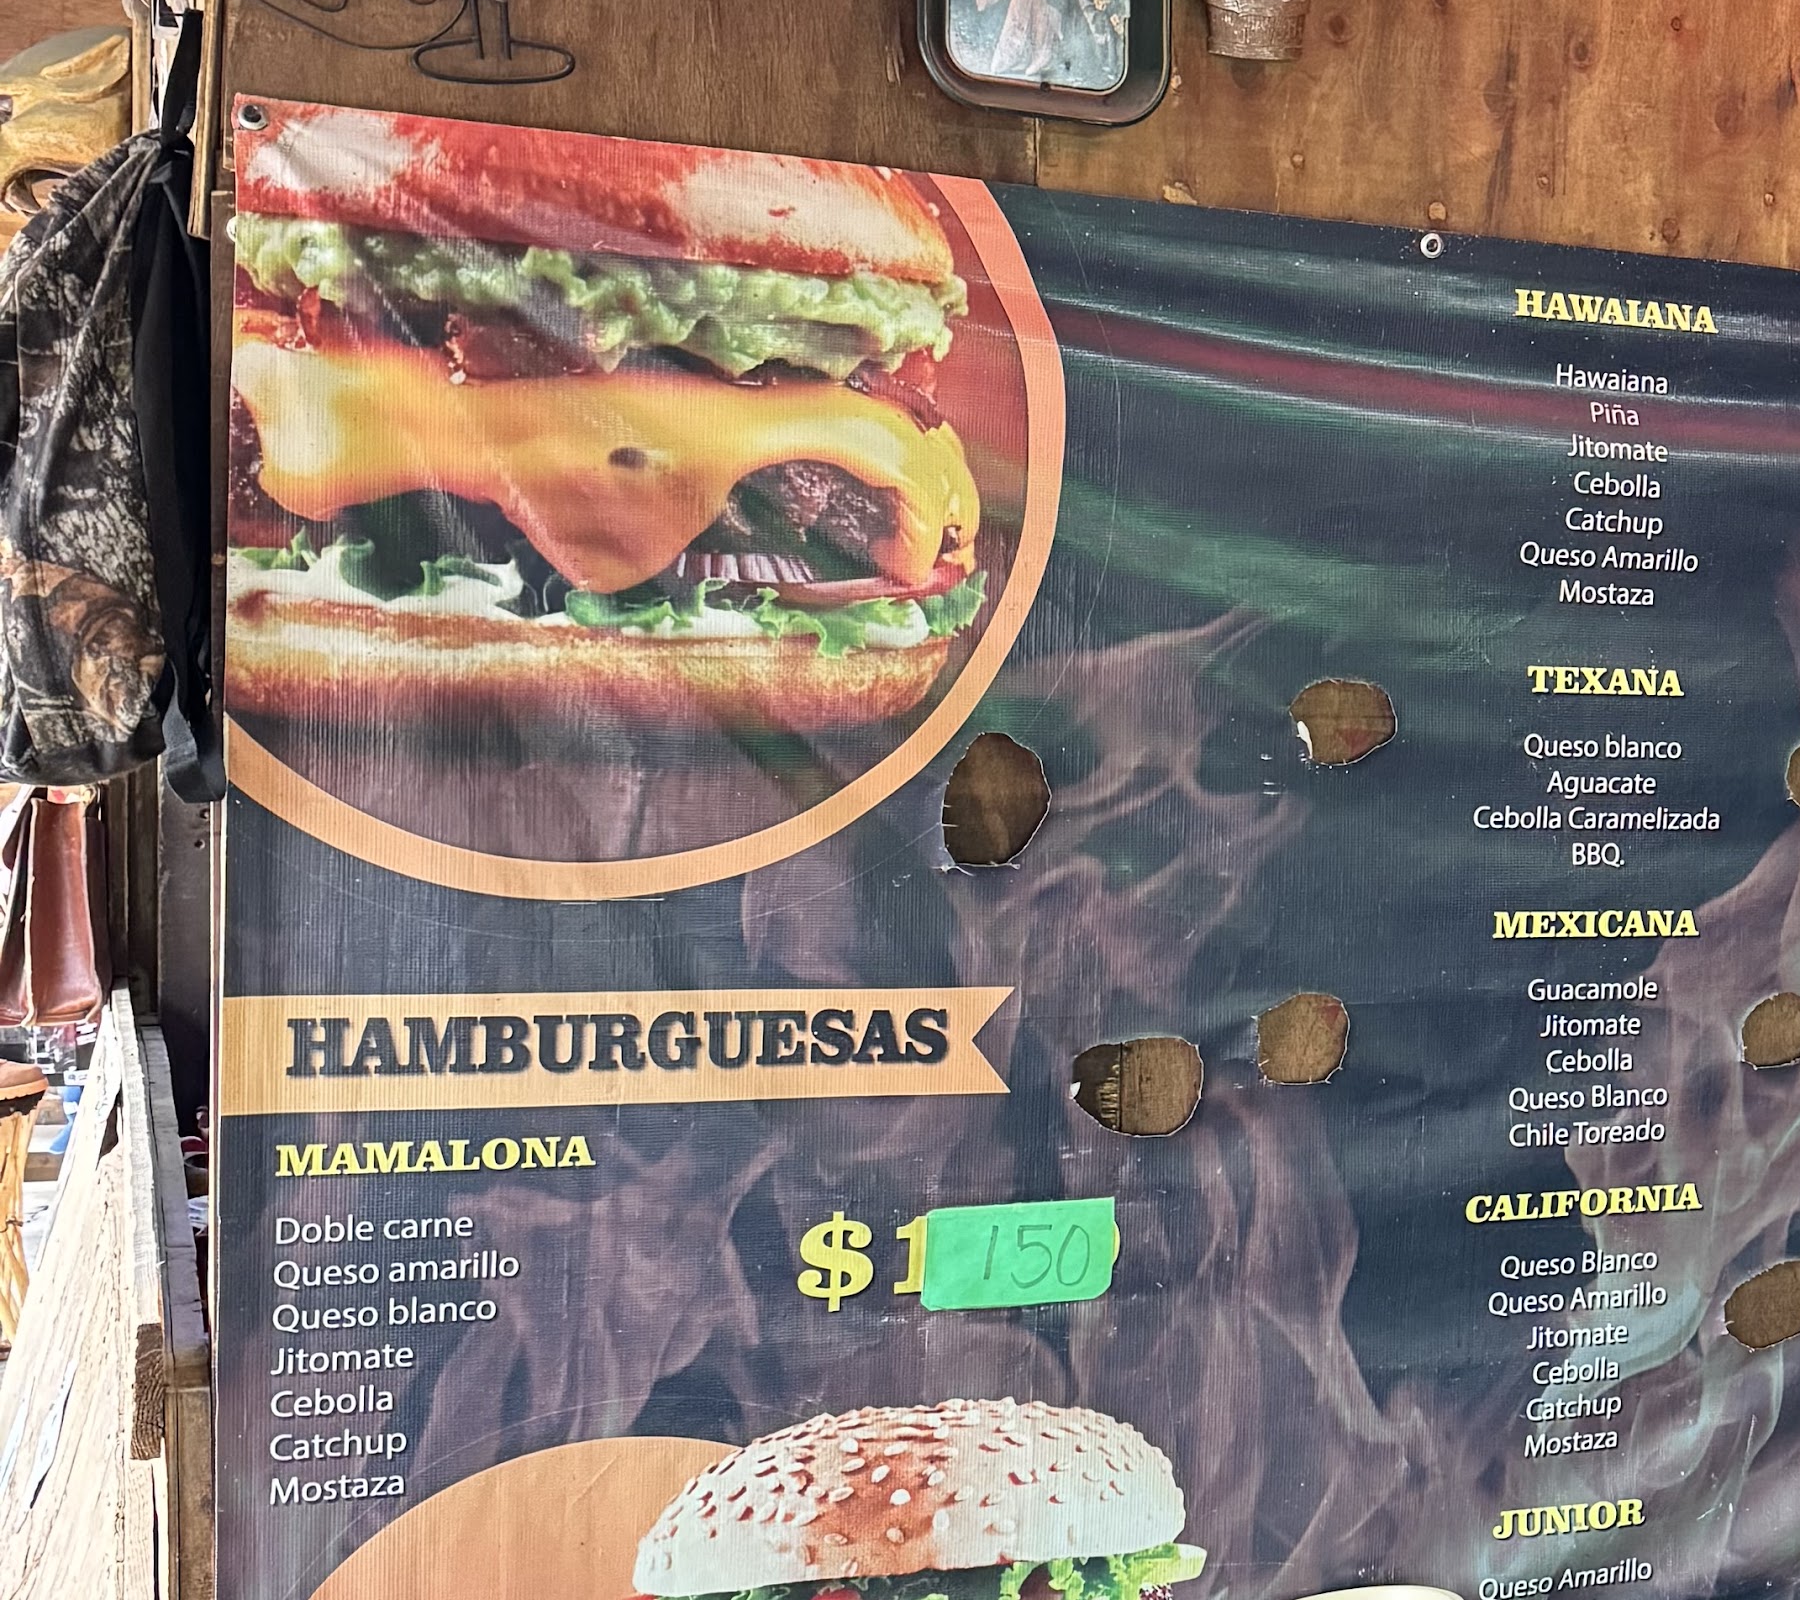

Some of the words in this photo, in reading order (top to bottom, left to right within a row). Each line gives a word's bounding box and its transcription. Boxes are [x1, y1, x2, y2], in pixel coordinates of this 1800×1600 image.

[1515, 288, 1719, 334] HAWAIANA
[1555, 363, 1669, 395] Hawaiana
[1590, 400, 1640, 427] Piña
[1567, 434, 1669, 463] Jitomate
[1573, 470, 1662, 499] Cebolla
[1565, 507, 1664, 537] Catchup
[1519, 540, 1596, 570] Queso
[1602, 545, 1699, 574] Amarillo
[1559, 579, 1656, 607] Mostaza
[1527, 664, 1685, 698] TEXANA
[1523, 733, 1598, 760] Queso
[1605, 734, 1683, 761] blanco
[1546, 769, 1657, 799] Aguacate
[1473, 805, 1562, 831] Cebolla
[1568, 806, 1721, 832] Caramelizada
[1571, 842, 1626, 869] BBQ.
[1492, 909, 1700, 940] MEXICANA
[1527, 976, 1658, 1004] Guacamole
[1540, 1013, 1642, 1040] Jitomate
[286, 1008, 949, 1078] HAMBURGUESAS
[1545, 1048, 1634, 1076] Cebolla
[1508, 1087, 1585, 1115] Queso
[1591, 1082, 1669, 1110] Blanco
[1508, 1121, 1570, 1149] Chile
[1580, 1118, 1666, 1146] Toreado
[275, 1136, 595, 1177] MAMALONA
[1464, 1182, 1703, 1225] CALIFORNIA
[275, 1214, 374, 1245] Doble
[383, 1212, 473, 1240] carne
[273, 1257, 379, 1290] Queso
[388, 1251, 520, 1284] amarillo
[981, 1222, 1093, 1290] 150
[1500, 1251, 1576, 1280] Queso
[1581, 1247, 1658, 1277] Blanco
[272, 1300, 379, 1333] Queso
[388, 1294, 497, 1325] blanco
[1488, 1288, 1565, 1318] Queso
[1571, 1282, 1668, 1311] Amarillo
[1526, 1320, 1629, 1352] Jitomate
[269, 1343, 414, 1378] Jitomate
[1532, 1357, 1620, 1386] Cebolla
[269, 1386, 394, 1420] Cebolla
[1525, 1392, 1623, 1424] Catchup
[269, 1428, 407, 1465] Catchup
[1523, 1428, 1619, 1459] Mostaza
[269, 1471, 405, 1507] Mostaza
[1492, 1498, 1646, 1540] JUNIOR
